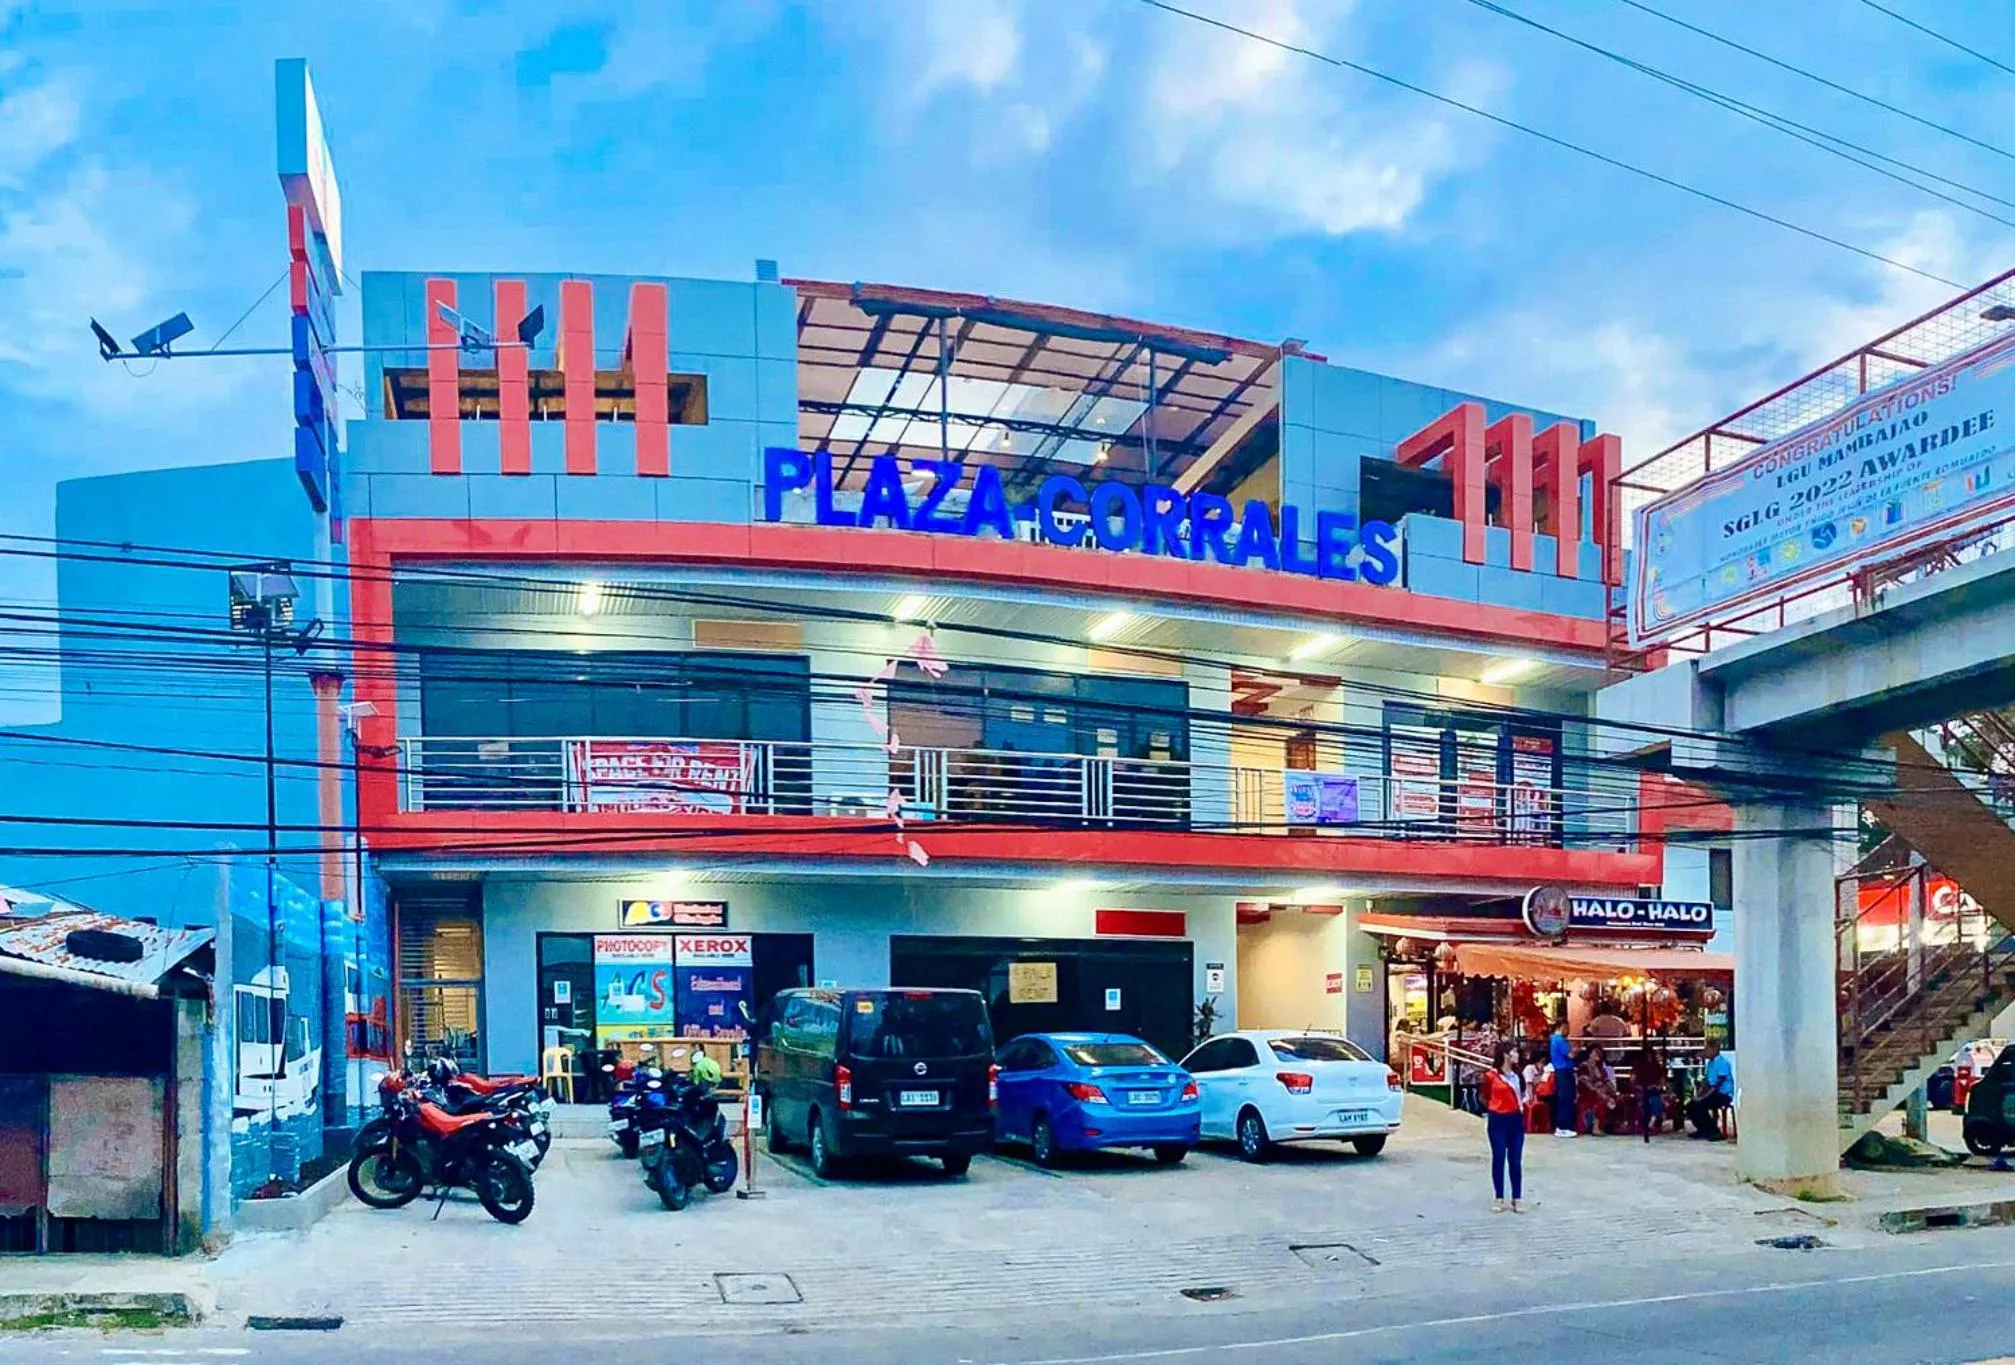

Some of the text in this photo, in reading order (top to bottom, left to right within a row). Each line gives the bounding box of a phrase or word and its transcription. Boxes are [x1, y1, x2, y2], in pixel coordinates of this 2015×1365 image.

[1752, 374, 1957, 480] CONGRATULATIONS!
[1776, 410, 1929, 489] LGU MAMBAJAO
[1723, 408, 1995, 538] SGLG 2022 AWARDEE
[597, 939, 667, 952] PHOTOCOPY
[680, 939, 748, 952] XEROX
